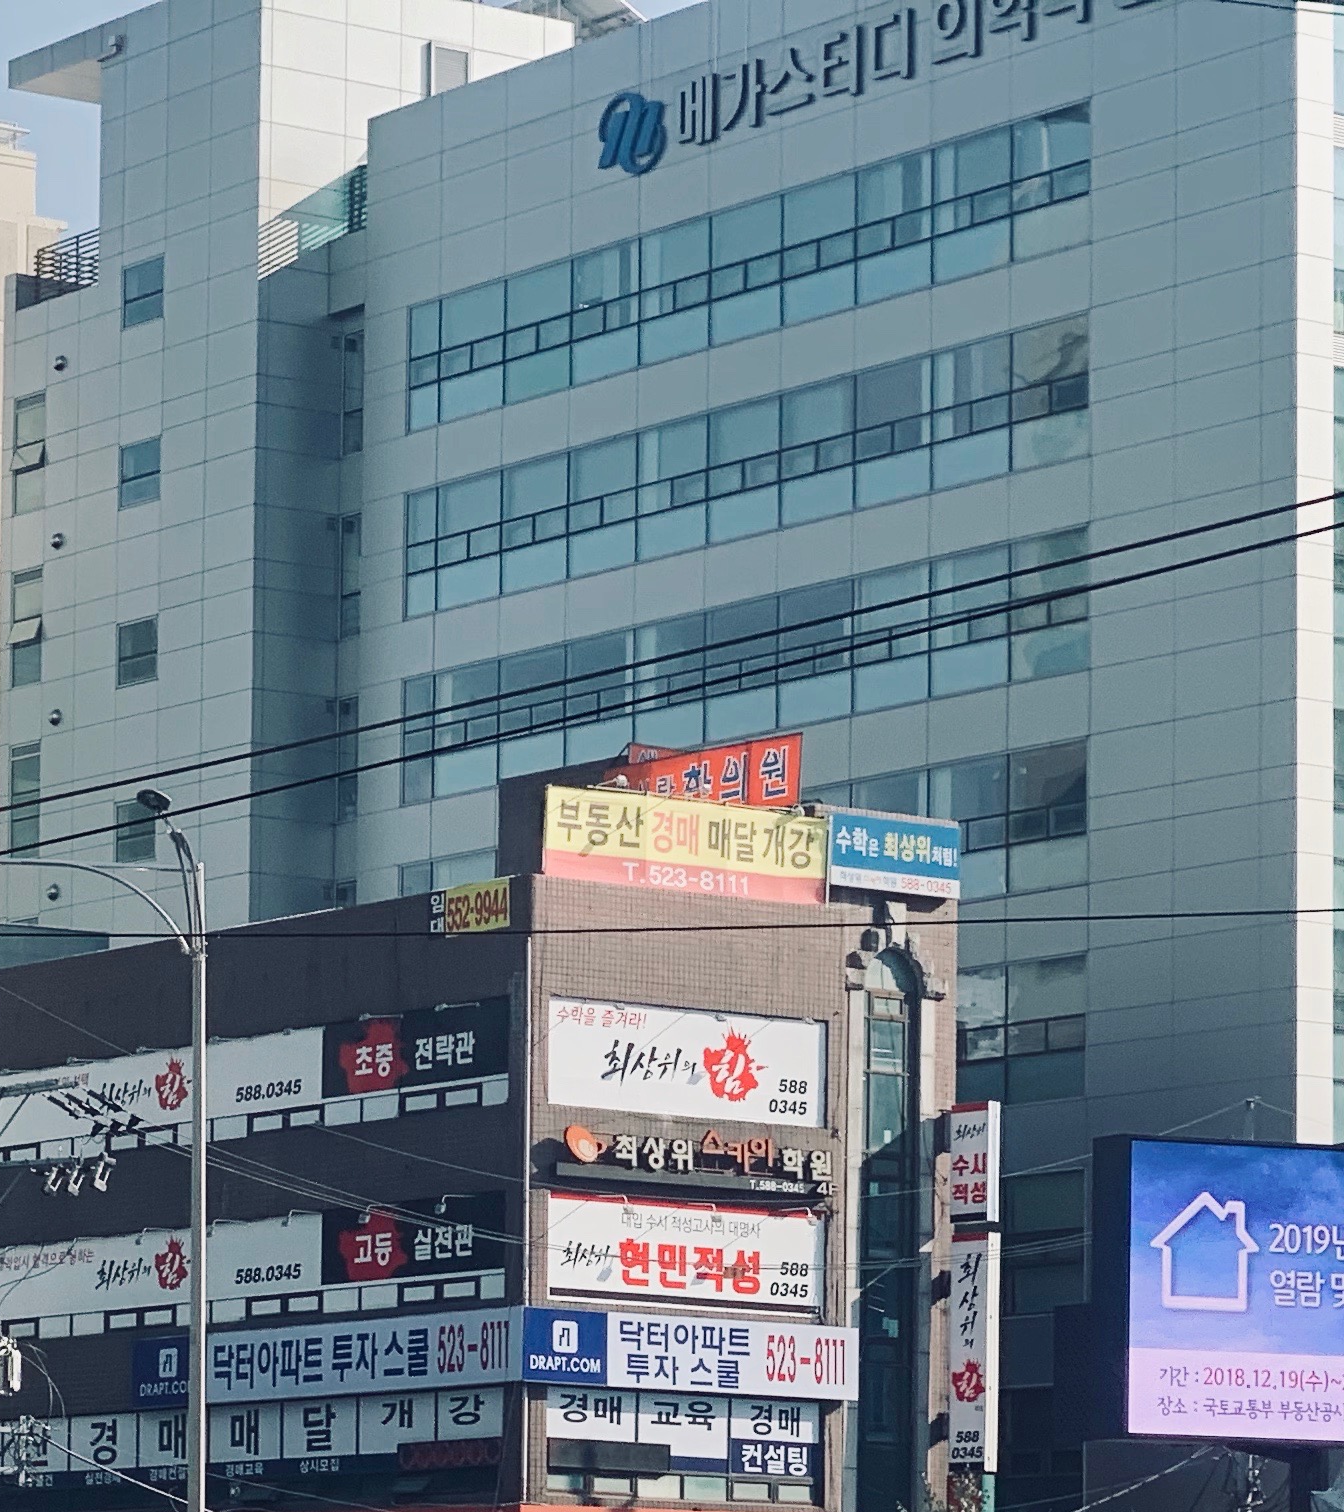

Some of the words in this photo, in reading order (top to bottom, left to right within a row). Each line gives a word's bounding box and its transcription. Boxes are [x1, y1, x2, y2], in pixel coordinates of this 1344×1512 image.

[678, 6, 916, 147] 메가스터디
[556, 800, 645, 850] 부동산
[651, 809, 701, 857] 경매
[708, 818, 757, 863] 매달
[762, 825, 815, 870] 개강
[835, 825, 879, 858] 수학은
[883, 831, 958, 868] 최상위처럼!
[622, 862, 749, 895] T.523-8111
[901, 877, 952, 894] 588-0345
[446, 891, 509, 932] 552-9944
[557, 1006, 596, 1026] 수학을
[601, 1009, 647, 1030] 즐겨라!
[354, 1043, 394, 1077] 초중
[415, 1030, 475, 1071] 전략관
[601, 1039, 697, 1086] 최상위의
[235, 1078, 302, 1103] 588.0345
[778, 1078, 808, 1095] 588
[768, 1099, 808, 1116] 0345
[615, 1133, 694, 1172] 최상위
[700, 1128, 774, 1174] 스카이
[781, 1147, 832, 1181] 학원
[952, 1152, 988, 1176] 수시
[749, 1179, 805, 1194] T.588-0345
[816, 1182, 838, 1197] 4F
[952, 1181, 988, 1206] 적성
[621, 1211, 643, 1229] 대입
[646, 1214, 667, 1231] 수시
[671, 1216, 725, 1235] 적성고사의
[728, 1220, 761, 1239] 대명사
[353, 1232, 393, 1266] 고등
[414, 1224, 474, 1262] 실전관
[234, 1263, 302, 1285] 588.0345
[561, 1241, 610, 1268] 최상위
[618, 1237, 761, 1295] 현민적성
[779, 1261, 809, 1277] 588
[769, 1281, 809, 1298] 0345
[1269, 1269, 1325, 1309] 열람
[213, 1337, 324, 1390] 닥터아파트
[331, 1332, 378, 1383] 투자
[384, 1327, 430, 1377] 스쿨
[437, 1320, 510, 1373] 523-8111
[619, 1320, 751, 1357] 닥터아파트
[529, 1353, 601, 1374] DRAPT.COM
[626, 1354, 680, 1386] 투자
[690, 1358, 740, 1389] 스쿨
[765, 1334, 846, 1386] 523-8111
[139, 1380, 189, 1398] DRAPT.CO
[1159, 1366, 1189, 1388] 기간
[230, 1402, 337, 1456] 매달
[381, 1394, 486, 1429] 개강
[560, 1392, 623, 1426] 경매
[650, 1400, 716, 1432] 교육
[749, 1403, 801, 1438] 경매
[1158, 1398, 1188, 1417] 장소
[1203, 1398, 1274, 1421] 국토교통부
[951, 1445, 983, 1460] 0345
[955, 1430, 980, 1443] 588
[741, 1443, 808, 1478] 컨설팅
